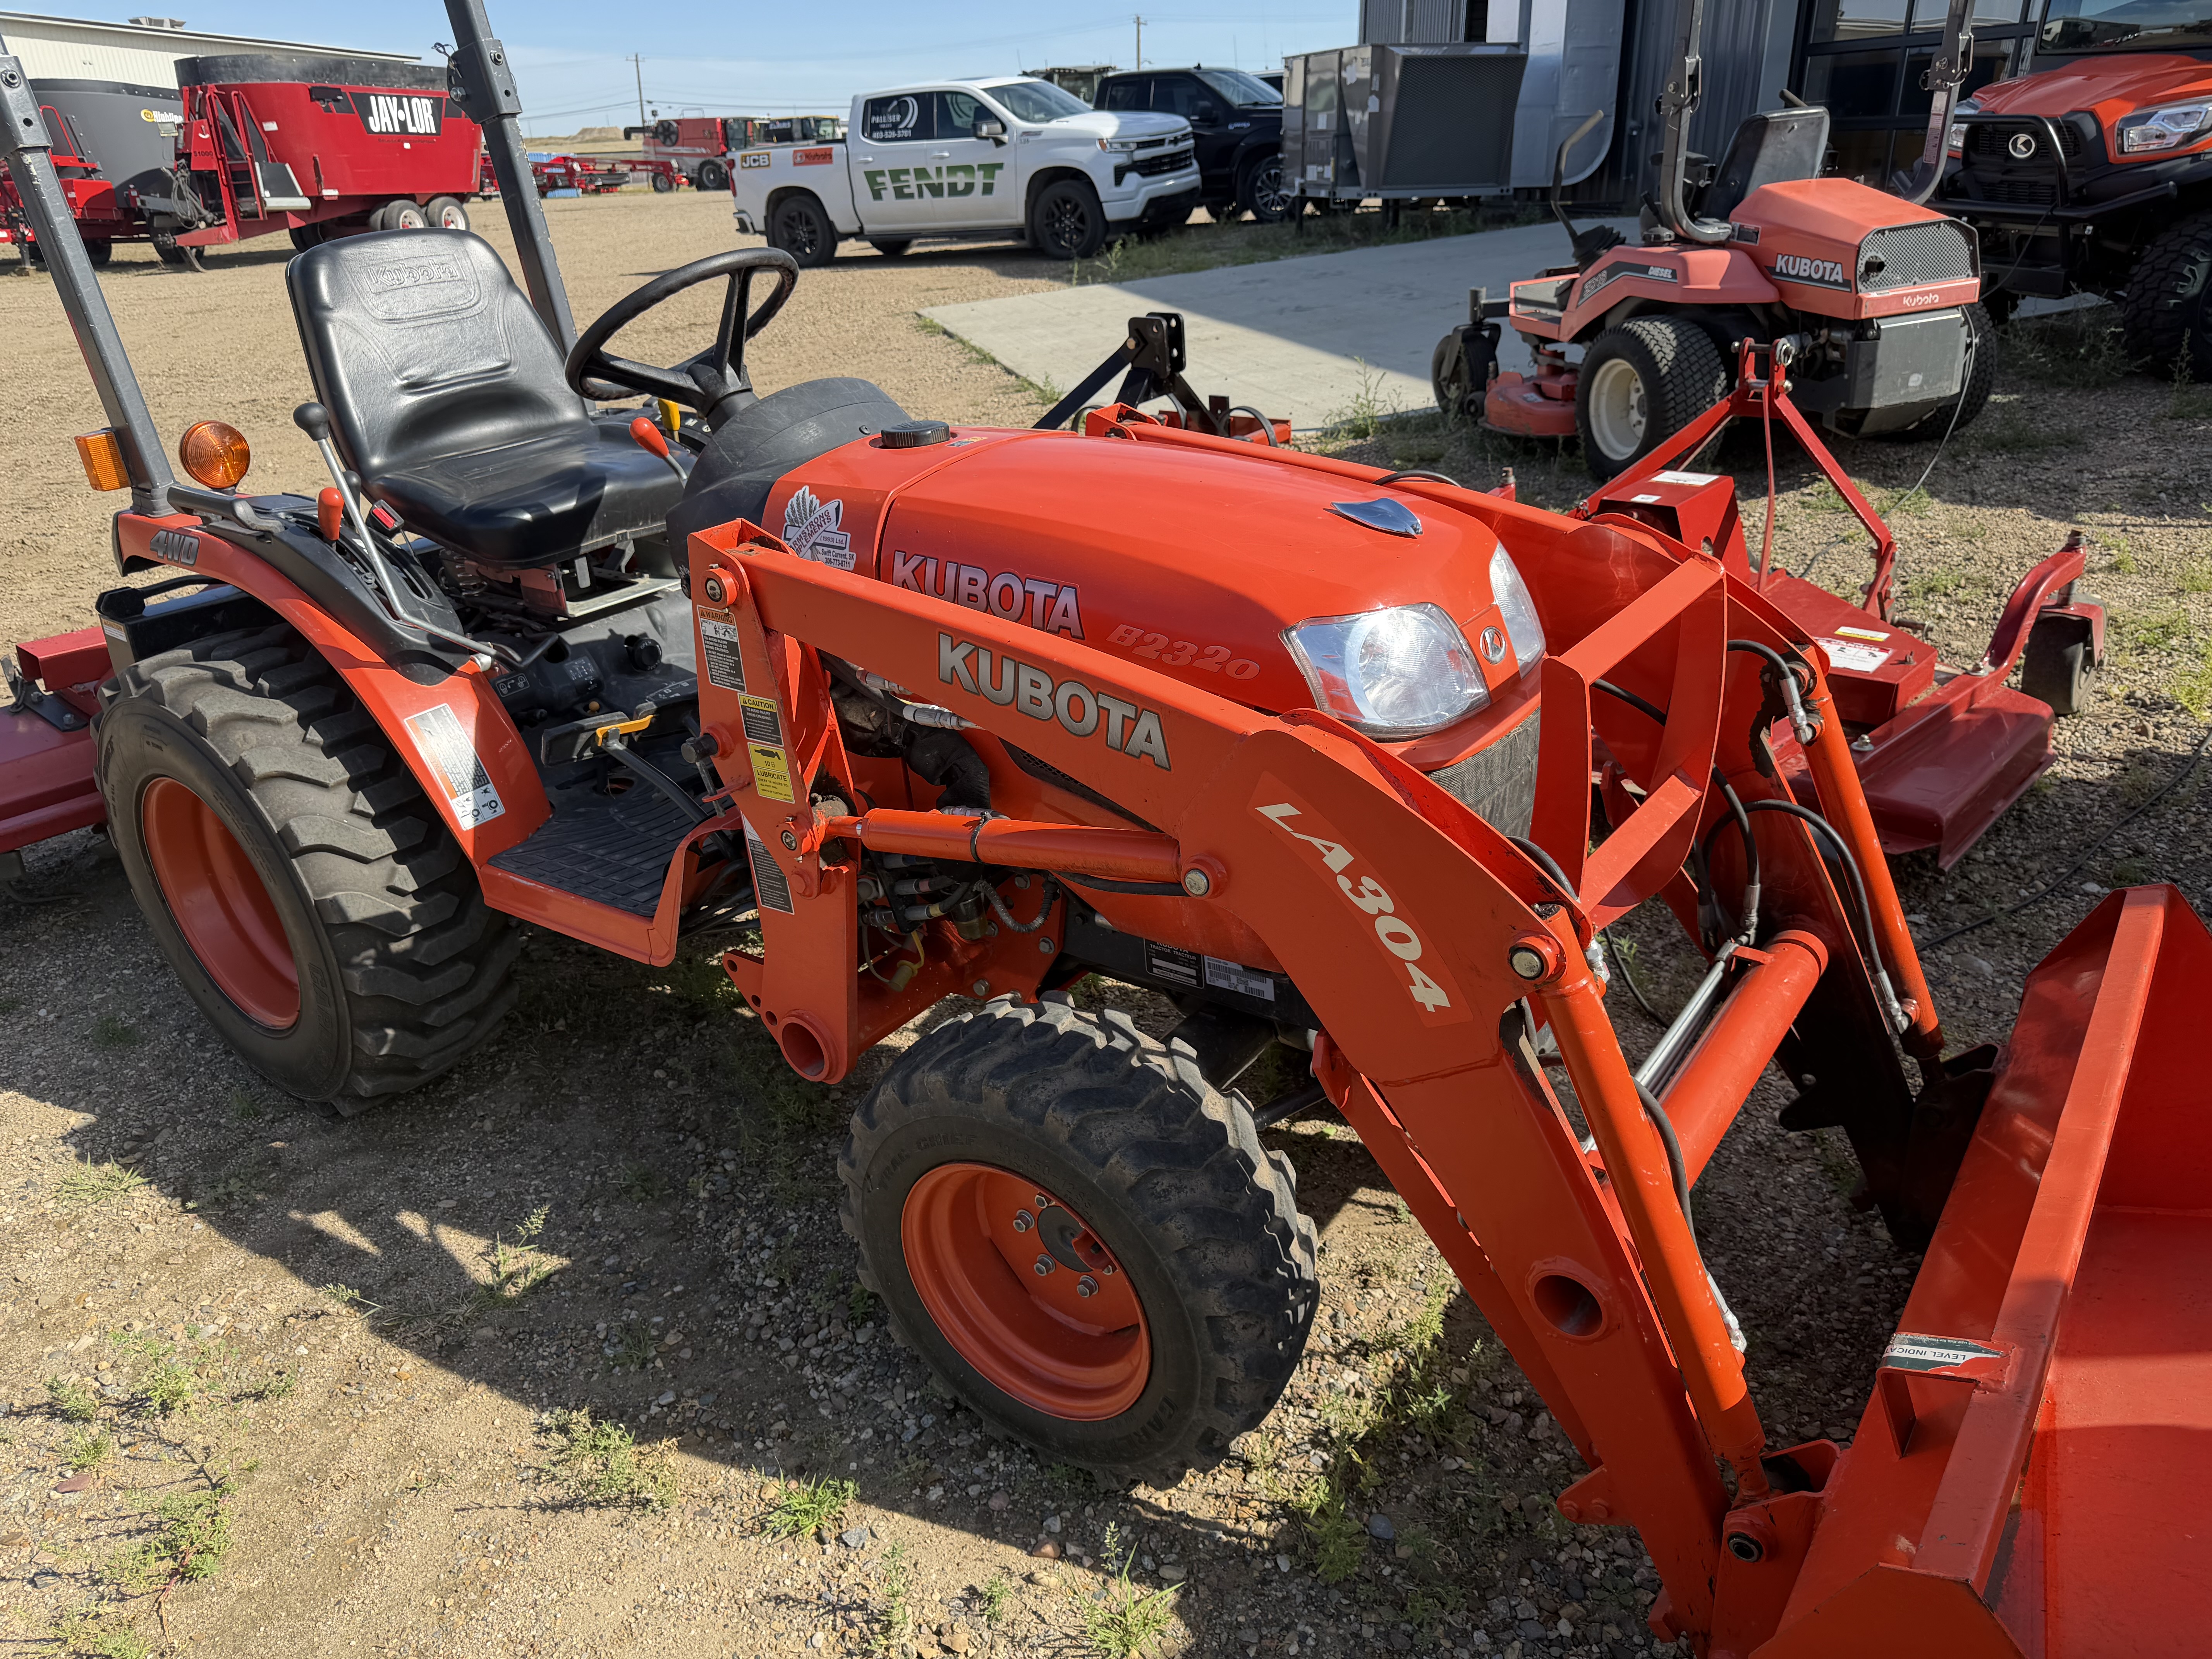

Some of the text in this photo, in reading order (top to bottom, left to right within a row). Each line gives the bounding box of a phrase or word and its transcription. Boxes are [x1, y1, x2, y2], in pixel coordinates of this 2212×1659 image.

[742, 155, 769, 167] JCB
[863, 162, 1004, 201] FENDT
[368, 259, 458, 286] Kubota
[1648, 266, 1672, 279] DIESEL
[1776, 253, 1843, 283] KUBOTA
[1903, 293, 1939, 307] Kubota
[791, 510, 830, 549] RMSTRONG
[795, 515, 831, 555] MPLEMENTS
[820, 535, 835, 544] (1993)
[150, 529, 200, 567] 4WD
[821, 548, 831, 557] Swift
[832, 551, 848, 561] Current,
[893, 550, 1085, 640] KUBOTA
[706, 611, 733, 623] WARNING
[1106, 624, 1260, 680] B2320
[747, 699, 774, 710] CAUTION
[939, 633, 1171, 771] KUBOTA
[757, 770, 788, 781] LUBRICATE
[1254, 803, 1451, 1012] LA304
[1150, 944, 1197, 961] TRACTOR TRACTEUR
[878, 1133, 977, 1191] TRAC CHIEF
[1930, 1351, 1966, 1360] LEVEL
